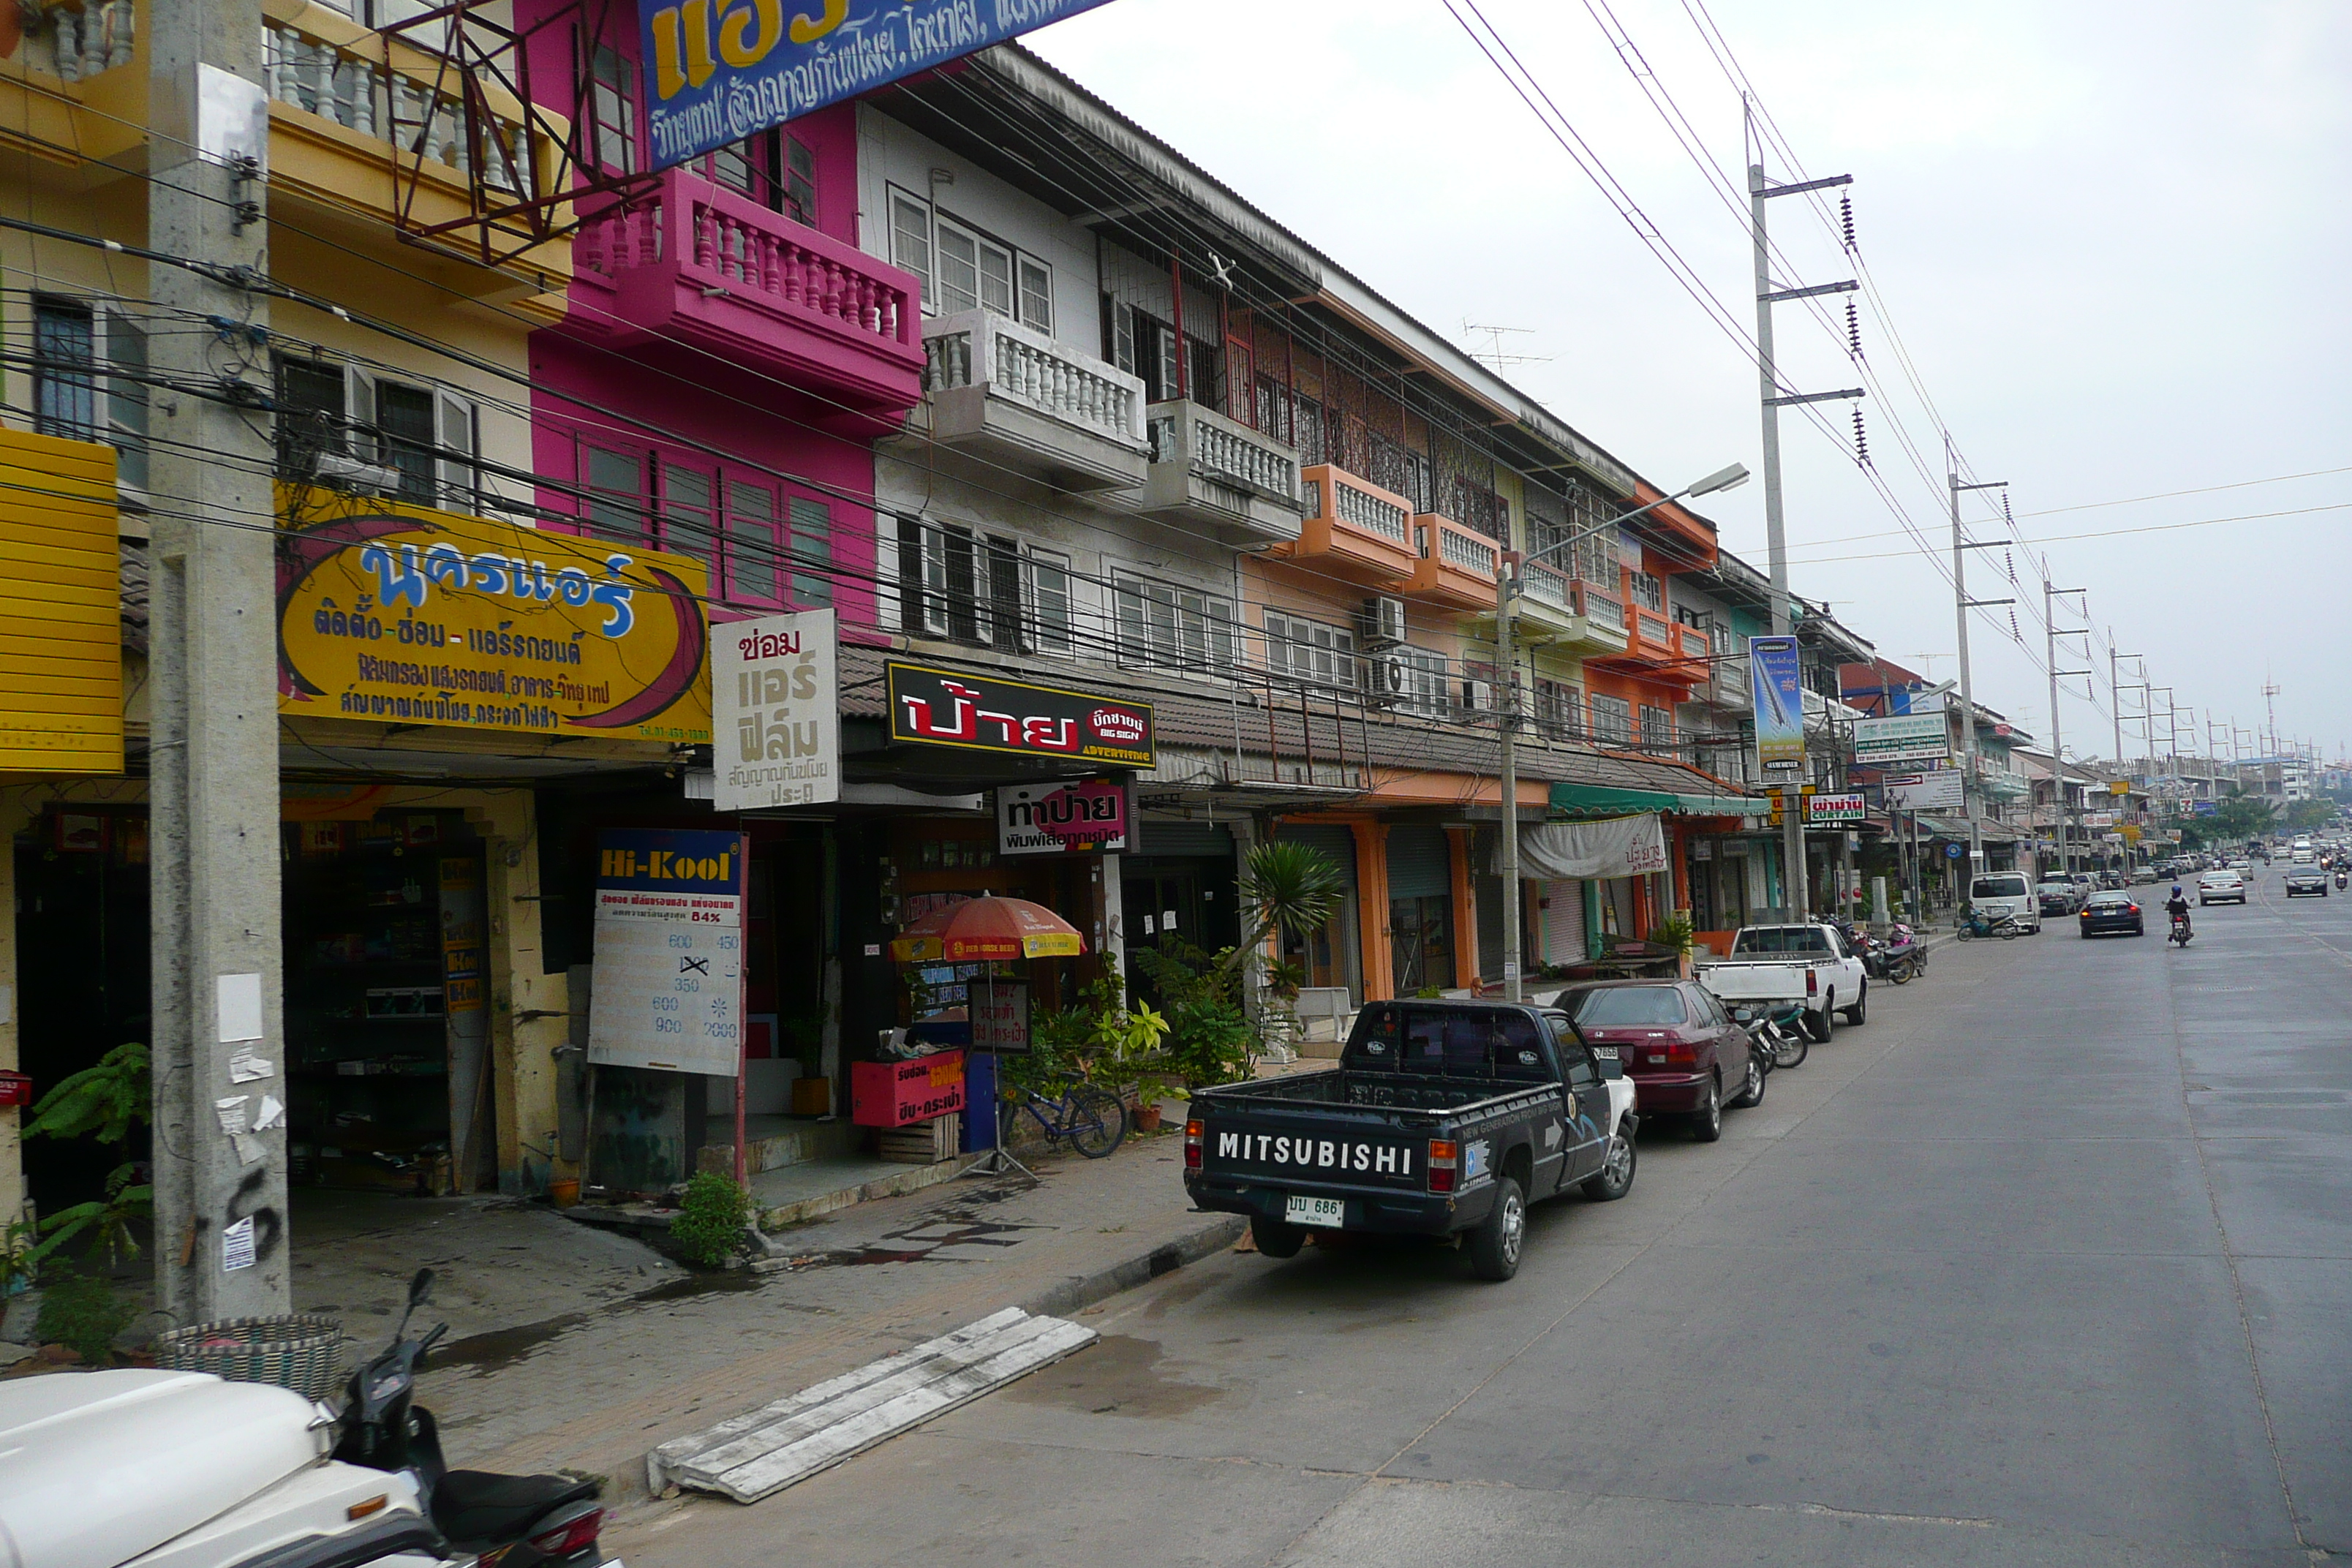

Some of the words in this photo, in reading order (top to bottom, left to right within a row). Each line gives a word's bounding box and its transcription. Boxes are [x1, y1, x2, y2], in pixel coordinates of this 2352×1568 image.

[360, 541, 635, 638] นครแอร์
[739, 628, 802, 661] ซ่อม
[737, 649, 818, 708] แอร์
[902, 679, 1079, 751] ป้าย
[736, 707, 819, 764] ฟิล์ม
[1100, 728, 1116, 737] BIG
[1116, 730, 1139, 740] SIGN
[728, 758, 828, 789] สัญญาณกันขโมย
[1008, 785, 1118, 827] ทำป้าย
[1812, 798, 1863, 811] ผ้าม่าน
[1812, 810, 1863, 820] CURTAIN
[1006, 827, 1119, 848] พิมพ์เสื้อทุกชนิด
[600, 849, 730, 881] Hi-Kool
[717, 935, 739, 949] 450
[1463, 1126, 1479, 1139] NEW
[1480, 1112, 1520, 1134] GENERATION
[1218, 1132, 1411, 1175] MITSUBISHI
[1315, 1199, 1338, 1214] 686
